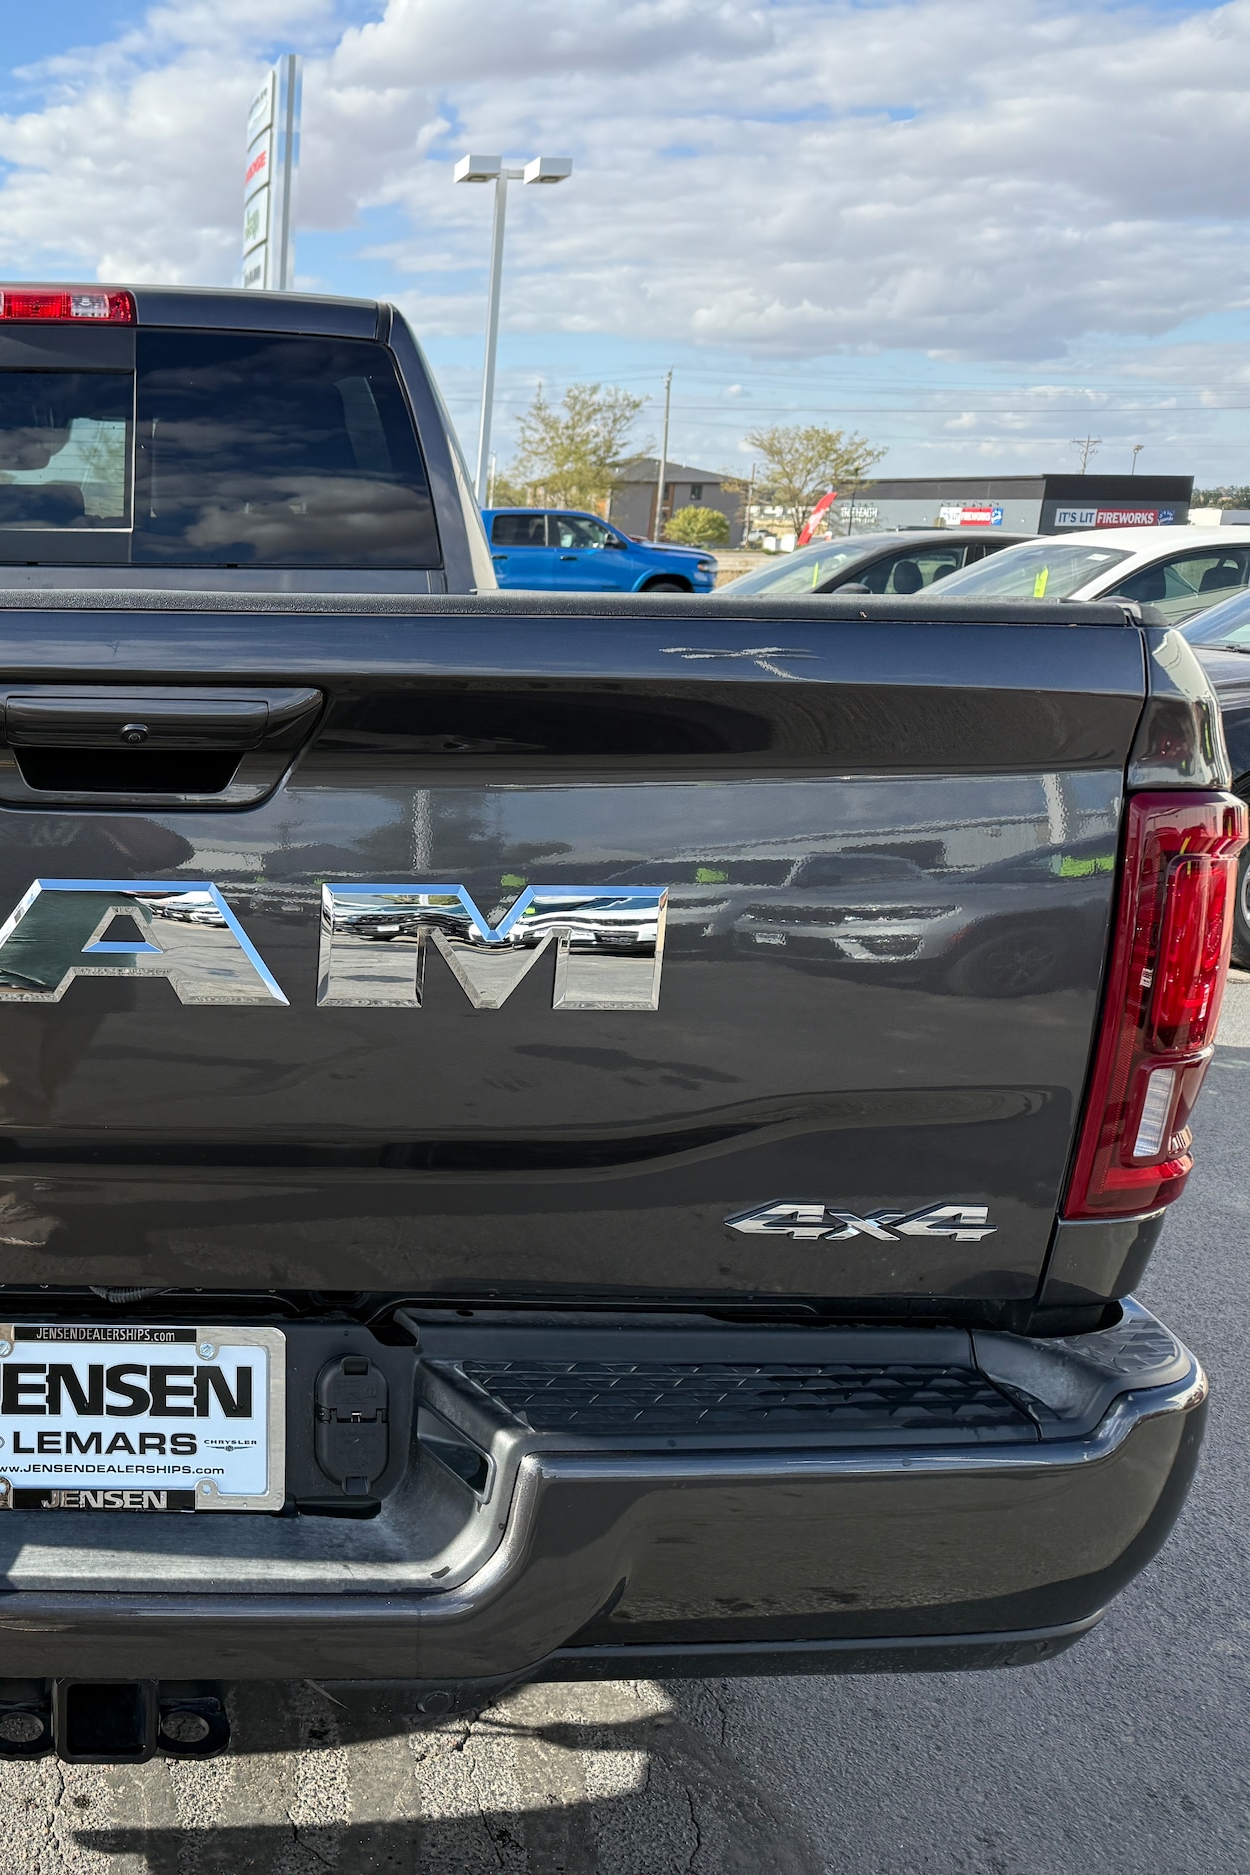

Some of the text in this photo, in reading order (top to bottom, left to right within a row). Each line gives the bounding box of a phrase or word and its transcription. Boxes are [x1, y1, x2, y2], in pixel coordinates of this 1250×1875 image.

[1059, 512, 1077, 523] IT'S
[1080, 512, 1095, 523] LIT
[1097, 512, 1155, 525] FIREWORKS
[36, 1327, 176, 1343] JENSENDEALERSHIPS.com
[13, 1430, 198, 1457] LEMARS
[41, 1489, 168, 1510] JENSEN
